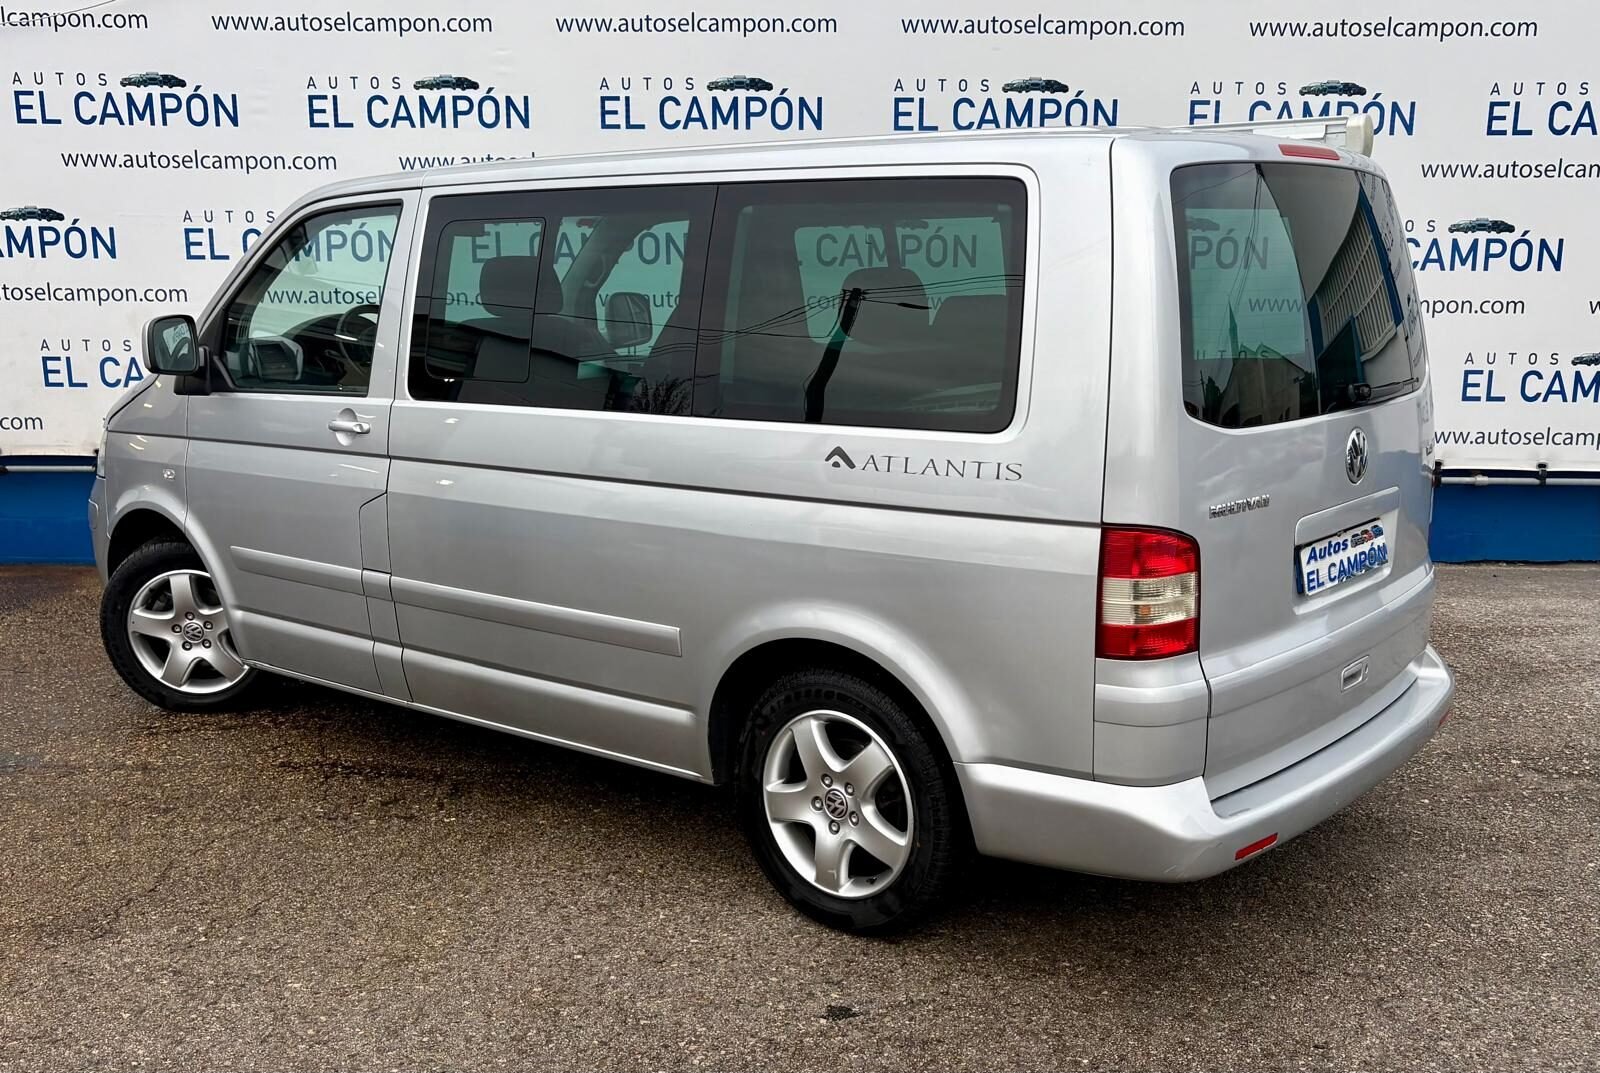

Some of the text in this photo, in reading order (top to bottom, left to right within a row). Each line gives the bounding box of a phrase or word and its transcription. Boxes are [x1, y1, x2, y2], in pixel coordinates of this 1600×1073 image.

[210, 10, 493, 38] www.autoselcampon.com
[555, 11, 837, 38] www.autoselcampon.com
[901, 13, 1185, 41] www.autoselcampon.com
[1249, 15, 1538, 43] www.autoselcampon.com
[12, 71, 108, 87] AUTOS
[306, 75, 401, 90] AUTOS
[599, 76, 695, 91] AUTOS
[893, 78, 990, 93] AUTOS
[1190, 80, 1287, 96] AUTOS
[1489, 81, 1589, 96] AUTOS
[13, 84, 239, 128] EL CAMPÓN
[307, 86, 530, 130] EL CAMPÓN
[599, 87, 823, 131] EL CAMPÓN
[893, 90, 1118, 131] EL CAMPÓN
[1485, 100, 1534, 137] EL
[60, 148, 337, 175] www.autoselcampon.com
[183, 210, 276, 223] AUTOS
[0, 218, 117, 260] MPÓN
[184, 228, 230, 260] EL
[40, 338, 132, 353] AUTOS
[1463, 351, 1560, 366] AUTOS
[41, 355, 89, 388] EL
[1460, 369, 1506, 403] EL
[861, 454, 1023, 481] ATLANTIS
[1306, 538, 1349, 566] Autos
[1306, 542, 1388, 592] EL CAMPÓN
